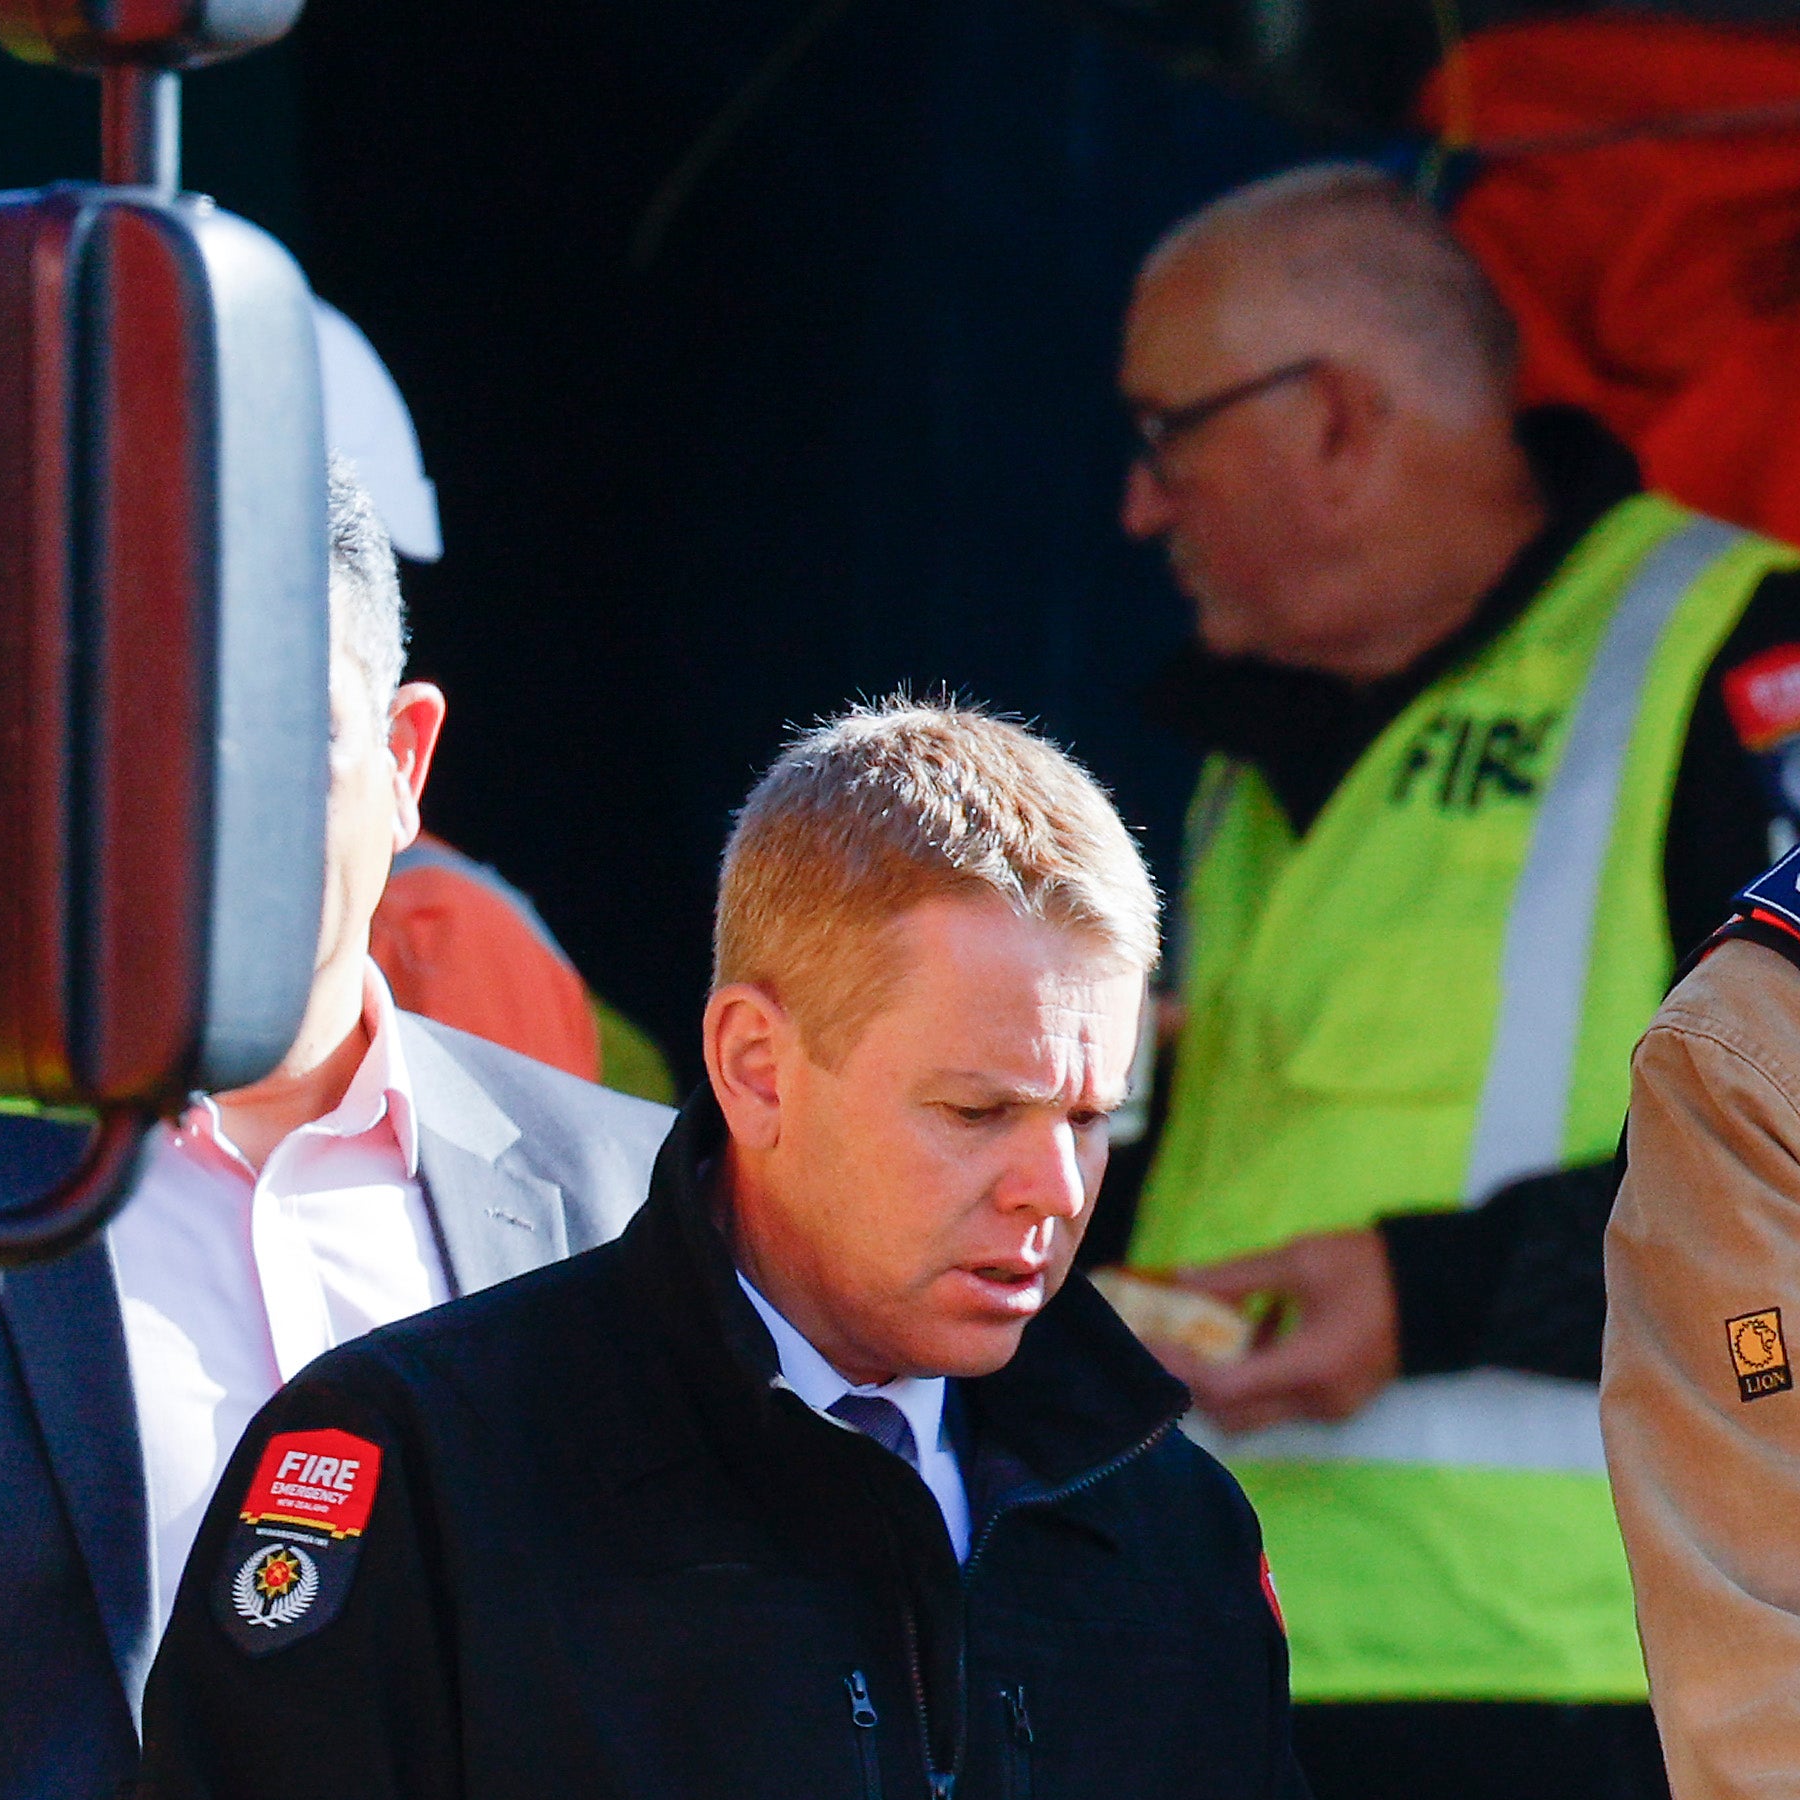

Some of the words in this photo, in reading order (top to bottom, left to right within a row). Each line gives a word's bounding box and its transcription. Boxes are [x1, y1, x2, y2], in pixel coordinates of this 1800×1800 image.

[1391, 711, 1562, 812] FIR
[1745, 1372, 1786, 1393] LION
[276, 1451, 360, 1491] FIRE
[270, 1482, 348, 1505] EMERGENCY
